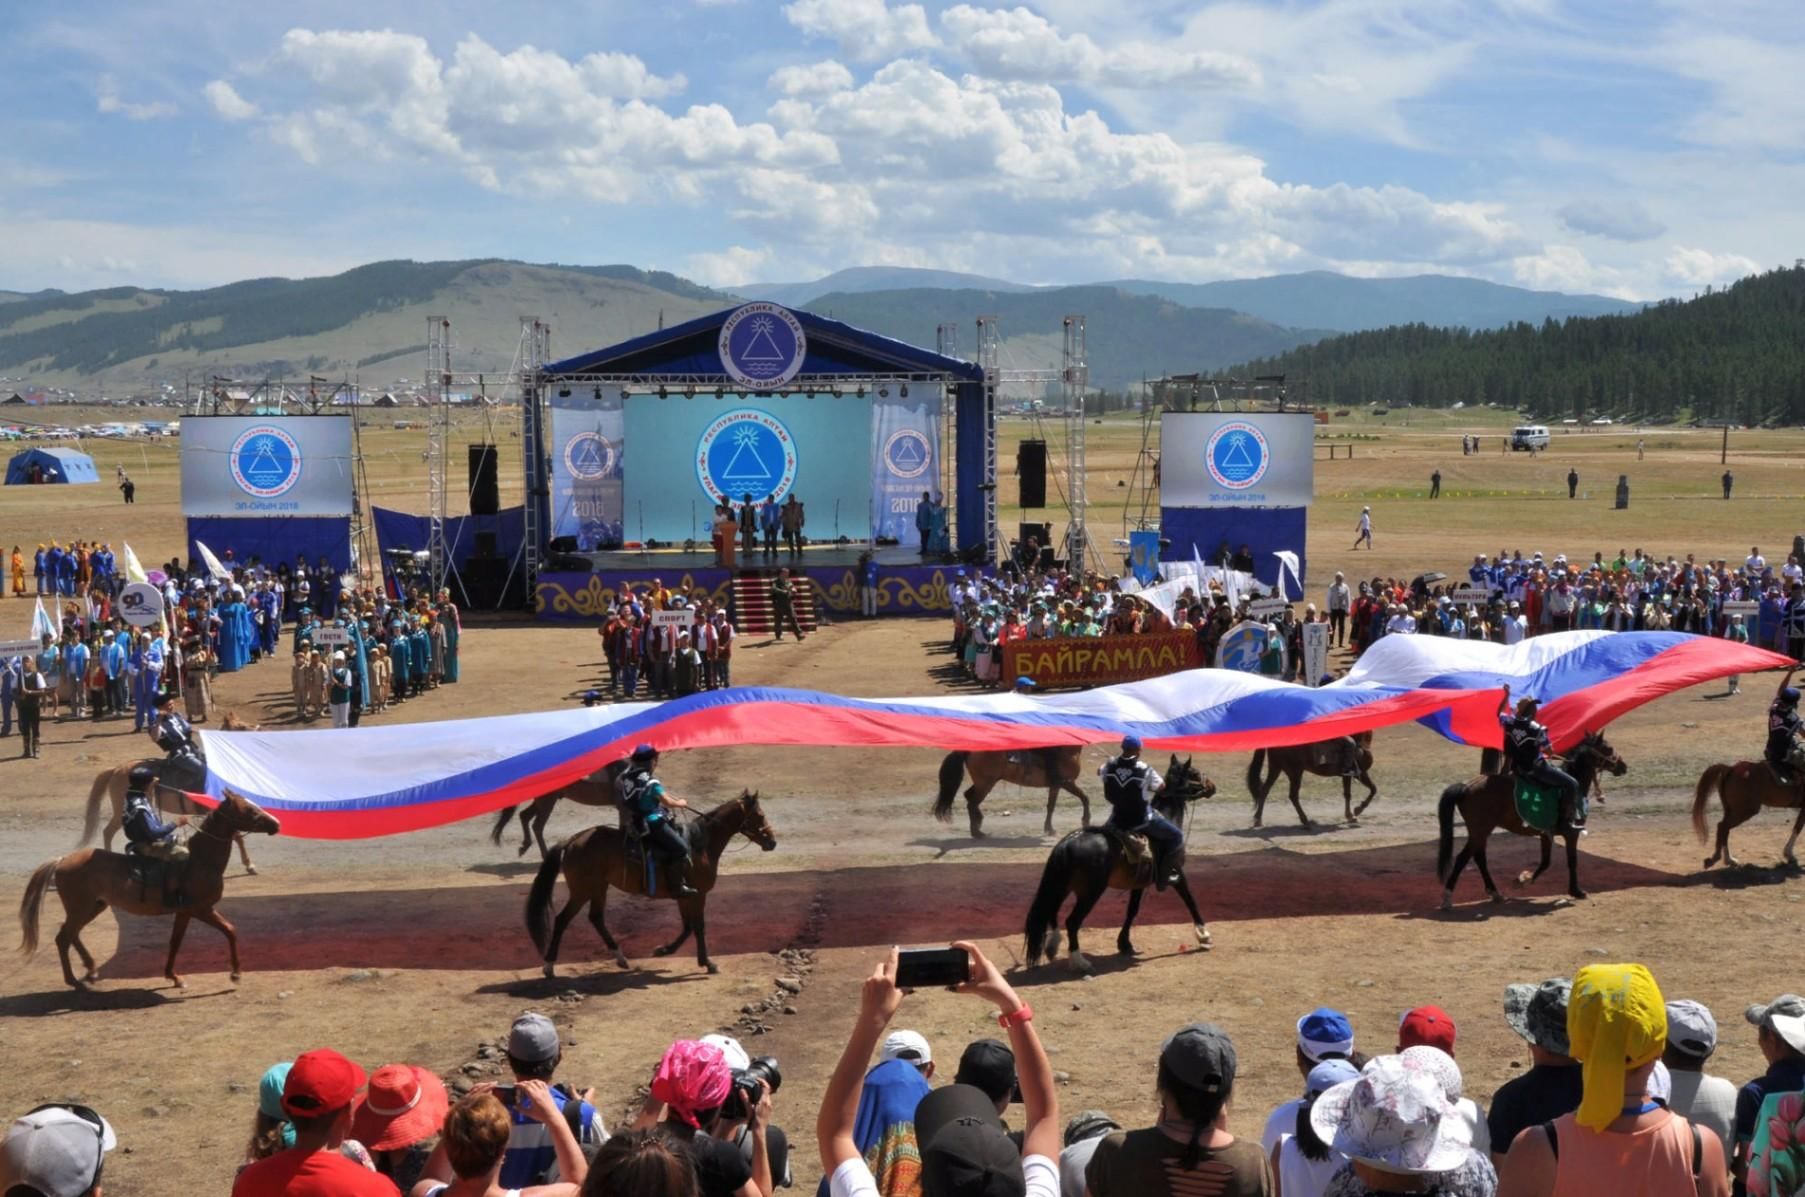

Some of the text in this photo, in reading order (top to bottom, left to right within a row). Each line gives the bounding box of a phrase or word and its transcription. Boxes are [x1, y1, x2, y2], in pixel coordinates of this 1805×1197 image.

[725, 304, 801, 332] РЕСПУБЛИКА АЛТАЙ
[704, 413, 788, 443] РЕСПУБЛИКА АЛТАЙ
[122, 591, 144, 609] 90
[1015, 644, 1186, 676] БАЙРАМЛА!
